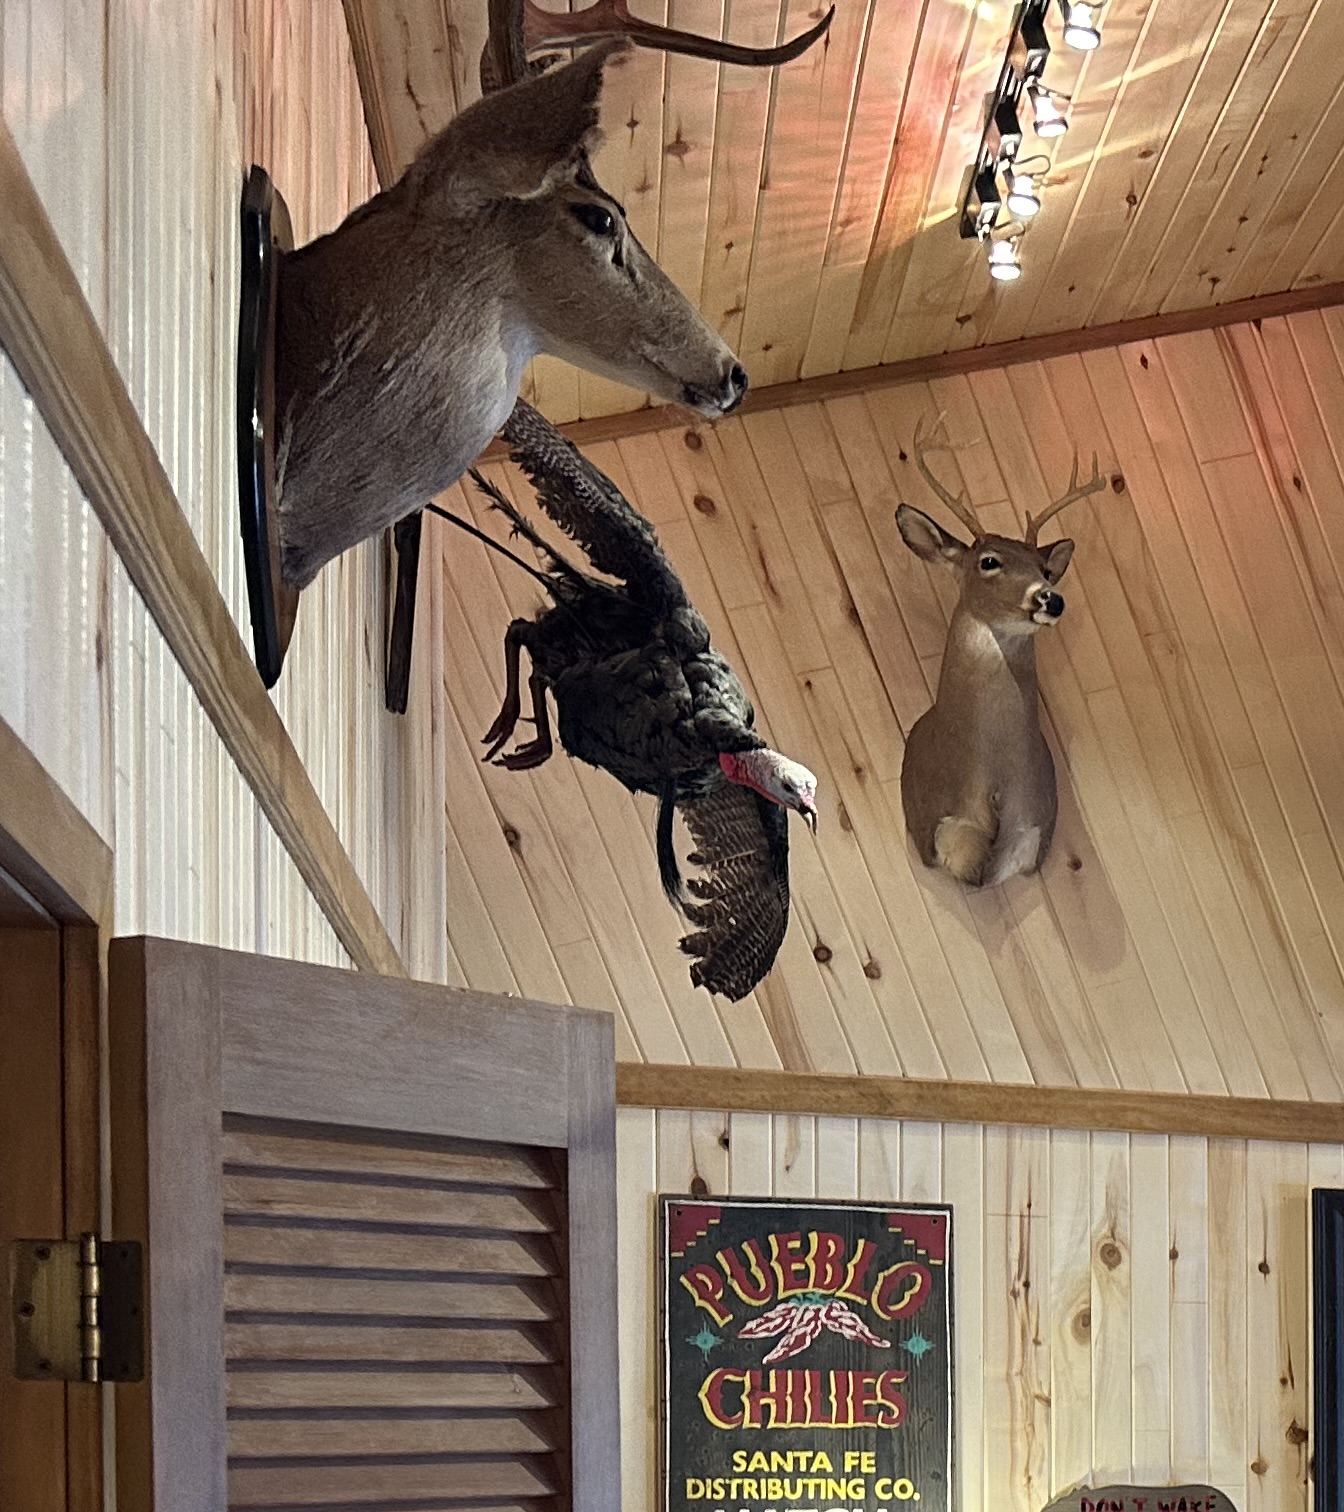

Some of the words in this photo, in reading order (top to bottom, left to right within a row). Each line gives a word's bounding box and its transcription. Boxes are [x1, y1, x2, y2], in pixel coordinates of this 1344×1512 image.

[680, 1231, 932, 1327] PUEBLO
[732, 1450, 833, 1473] SANTA
[844, 1451, 876, 1473] FE
[686, 1478, 865, 1500] DISTRIBUTING
[875, 1478, 920, 1501] CO.
